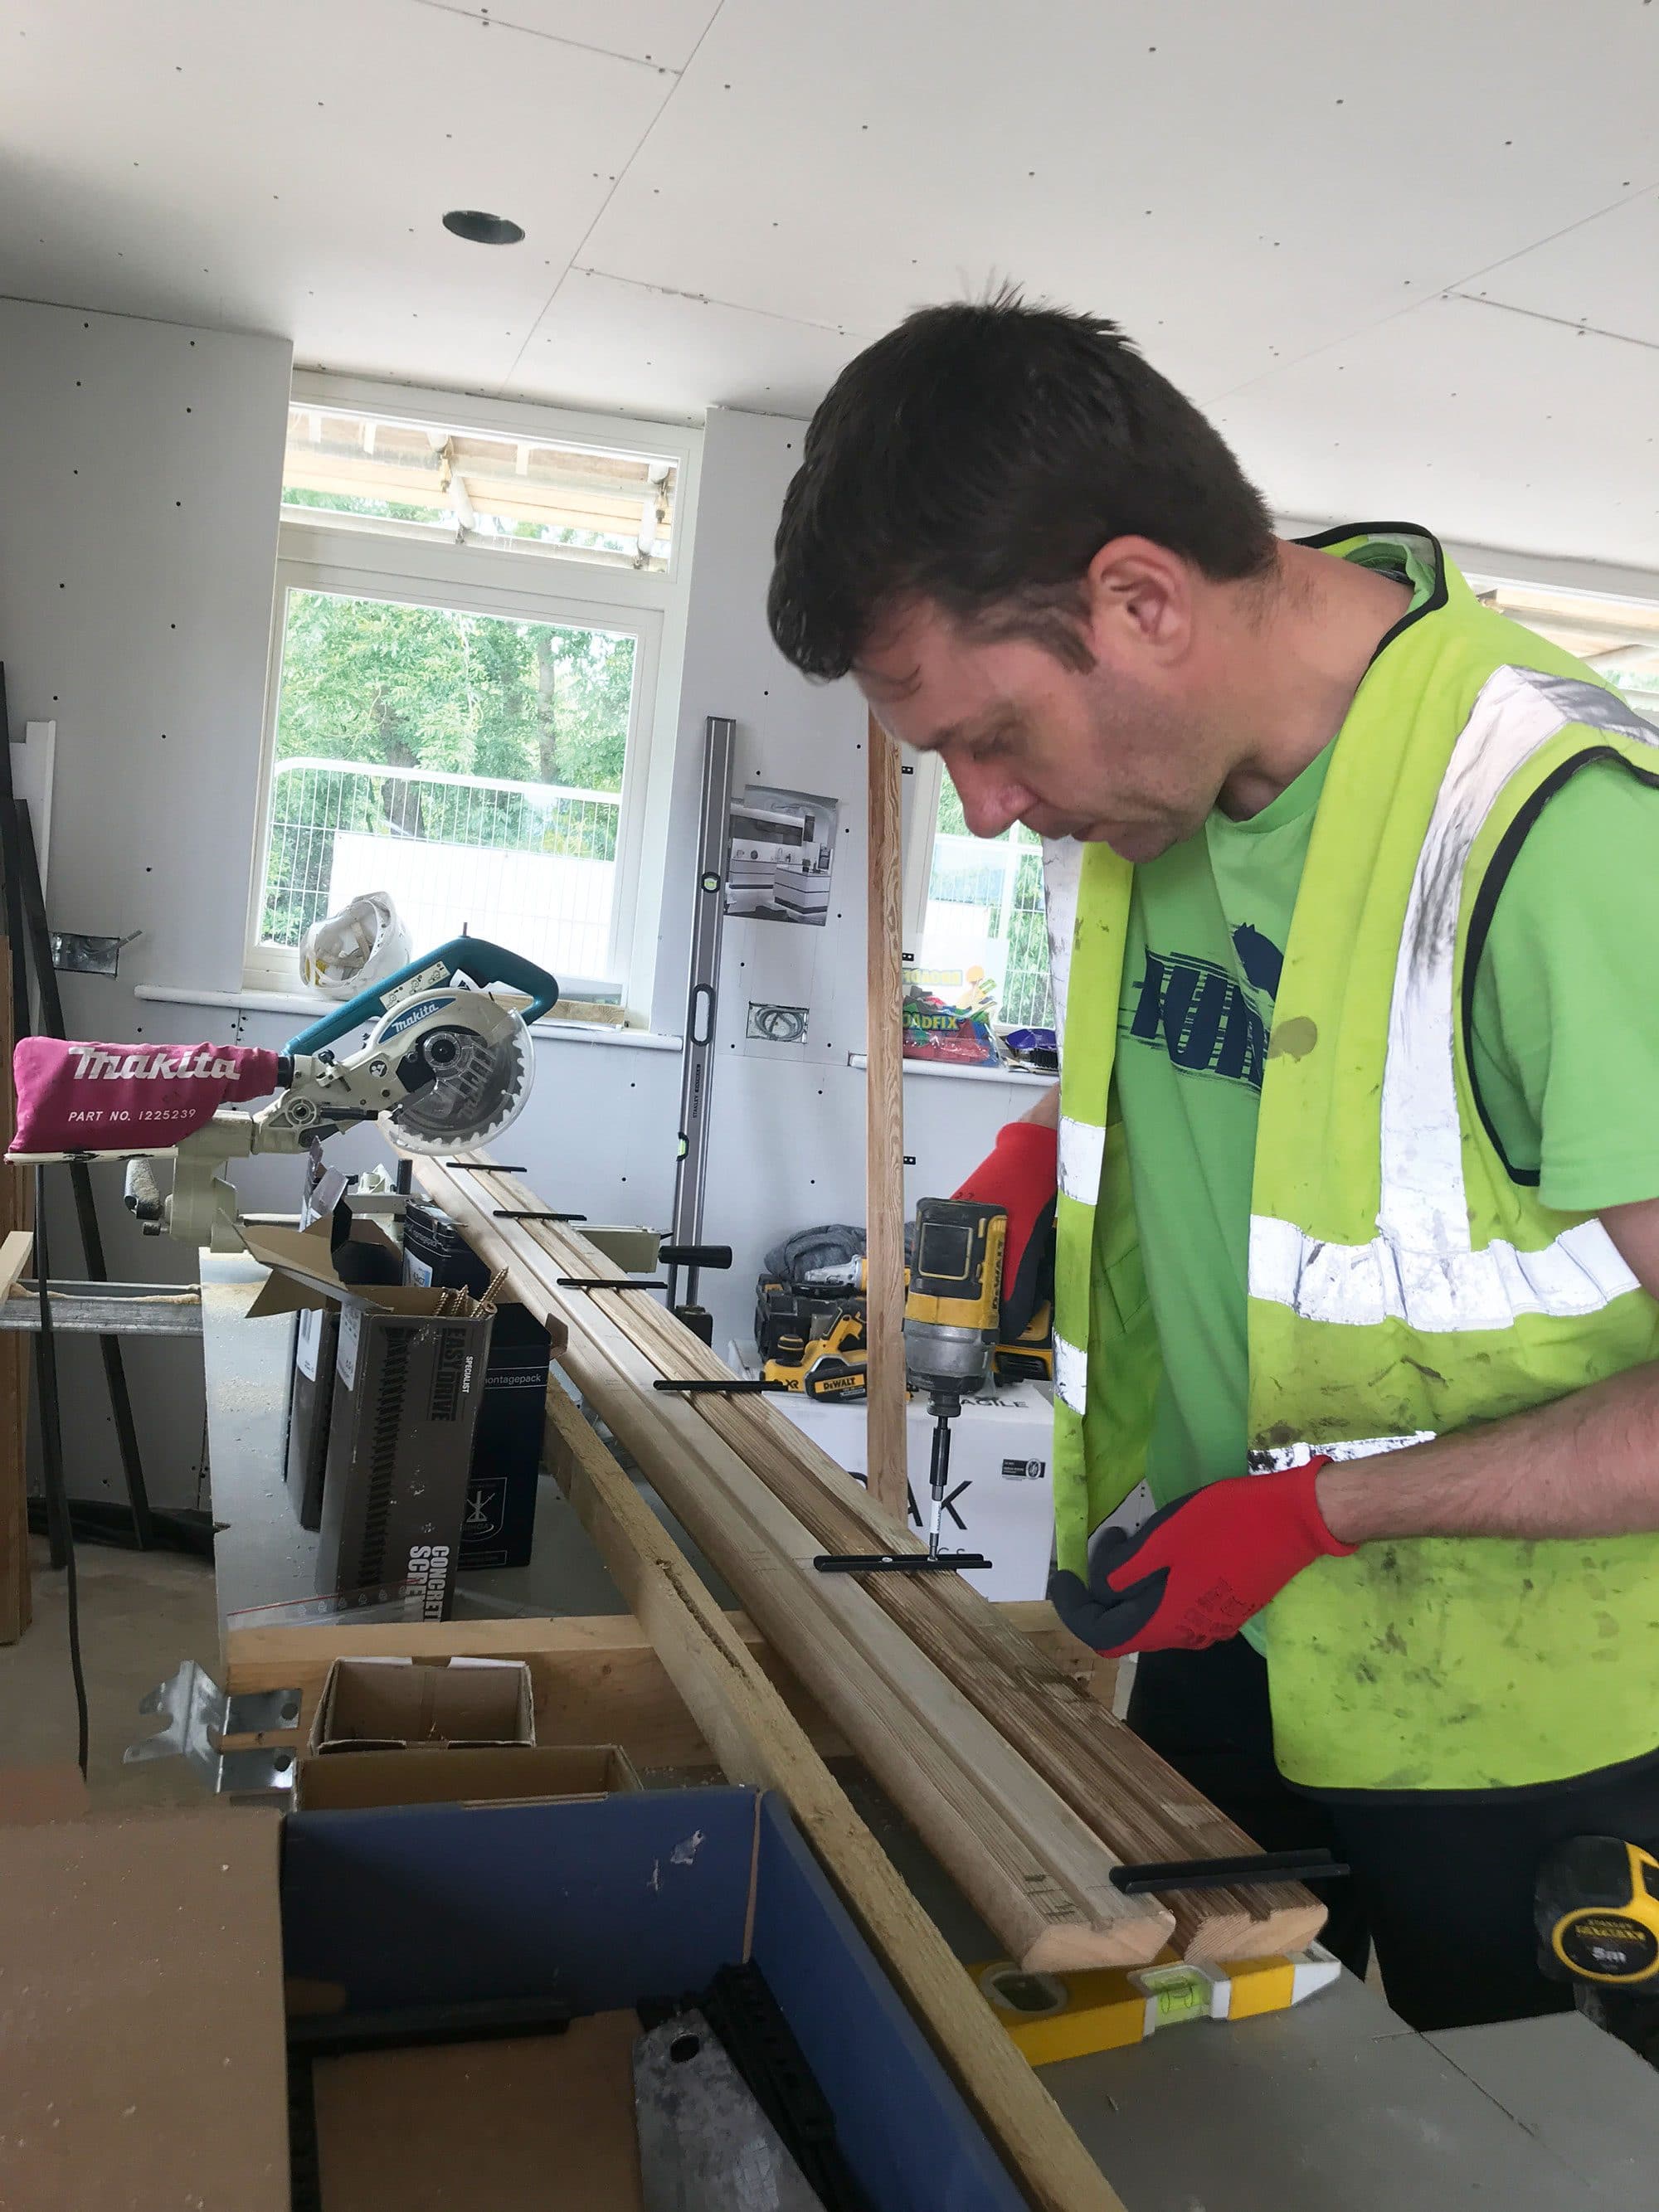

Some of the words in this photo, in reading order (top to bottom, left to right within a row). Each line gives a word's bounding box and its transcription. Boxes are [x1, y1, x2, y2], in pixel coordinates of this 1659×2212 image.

[902, 1013, 957, 1029] OADFIX
[68, 1111, 103, 1121] PART
[109, 1110, 131, 1121] NO.
[139, 1108, 197, 1121] 1225239
[462, 1355, 474, 1393] SPECIALIST
[485, 1373, 542, 1385] ontagepack
[961, 1398, 1029, 1408] AGILE
